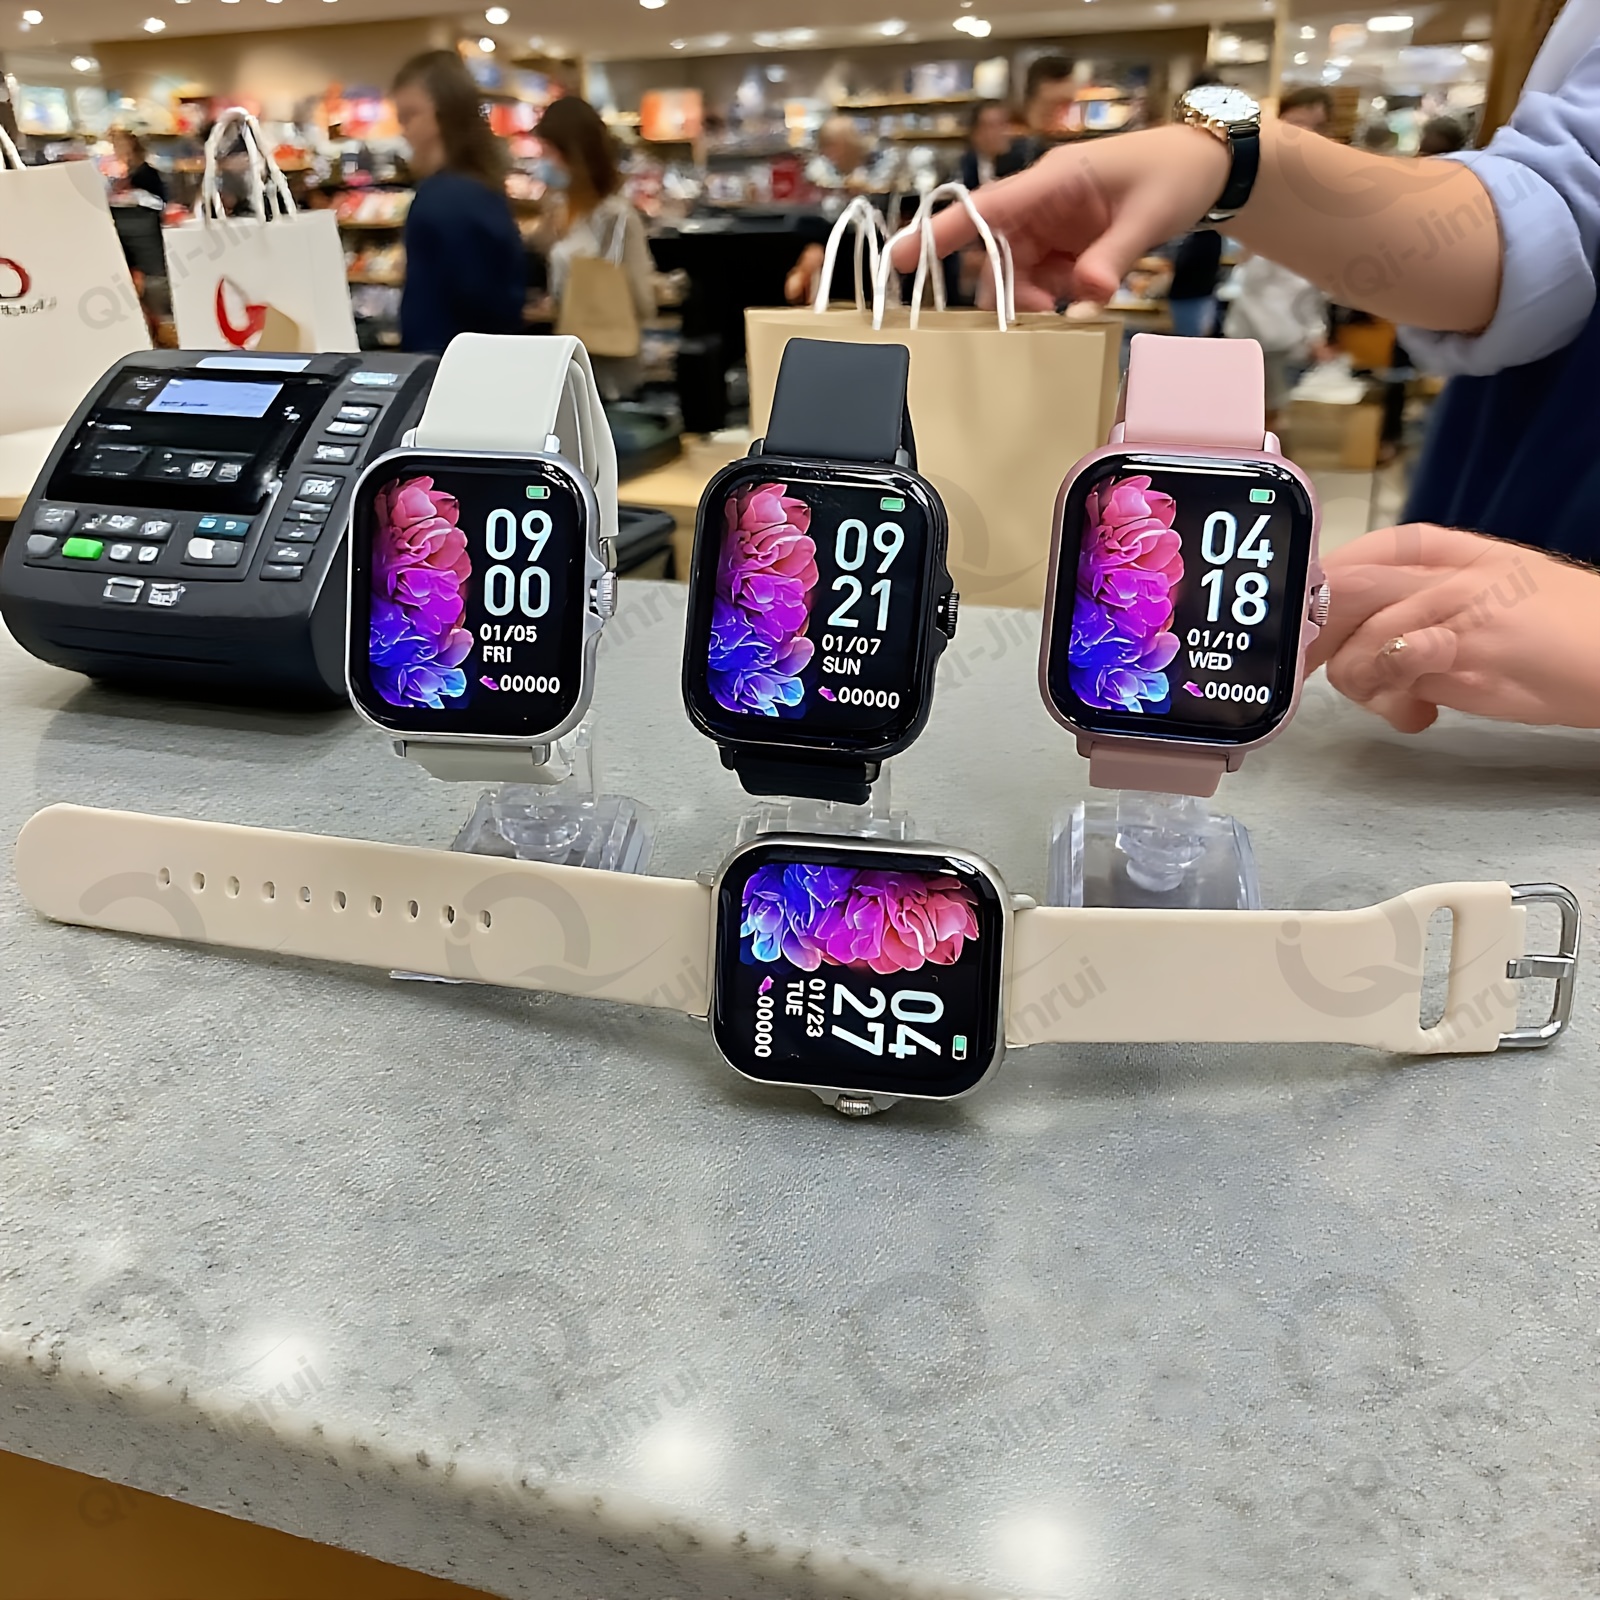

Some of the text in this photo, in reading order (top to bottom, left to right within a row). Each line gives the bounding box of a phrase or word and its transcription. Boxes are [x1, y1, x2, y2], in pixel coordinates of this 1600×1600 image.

[486, 508, 552, 561] 09
[836, 518, 904, 573] 09
[1201, 511, 1274, 568] 04
[484, 565, 550, 617] 00
[828, 575, 891, 631] 21
[1201, 569, 1268, 625] 18
[480, 624, 537, 642] 01/05
[483, 646, 512, 662] FRI
[822, 634, 881, 655] 01/07
[1187, 628, 1249, 650] 01/10
[822, 656, 860, 675] SUN
[1189, 651, 1232, 670] WED
[500, 675, 560, 693] 00000
[838, 687, 899, 709] 00000
[1205, 682, 1269, 704] 00000
[786, 980, 804, 1016] TUE
[806, 979, 826, 1037] 01/23
[832, 984, 886, 1055] 27
[755, 996, 774, 1057] 00000
[888, 990, 944, 1059] 04
